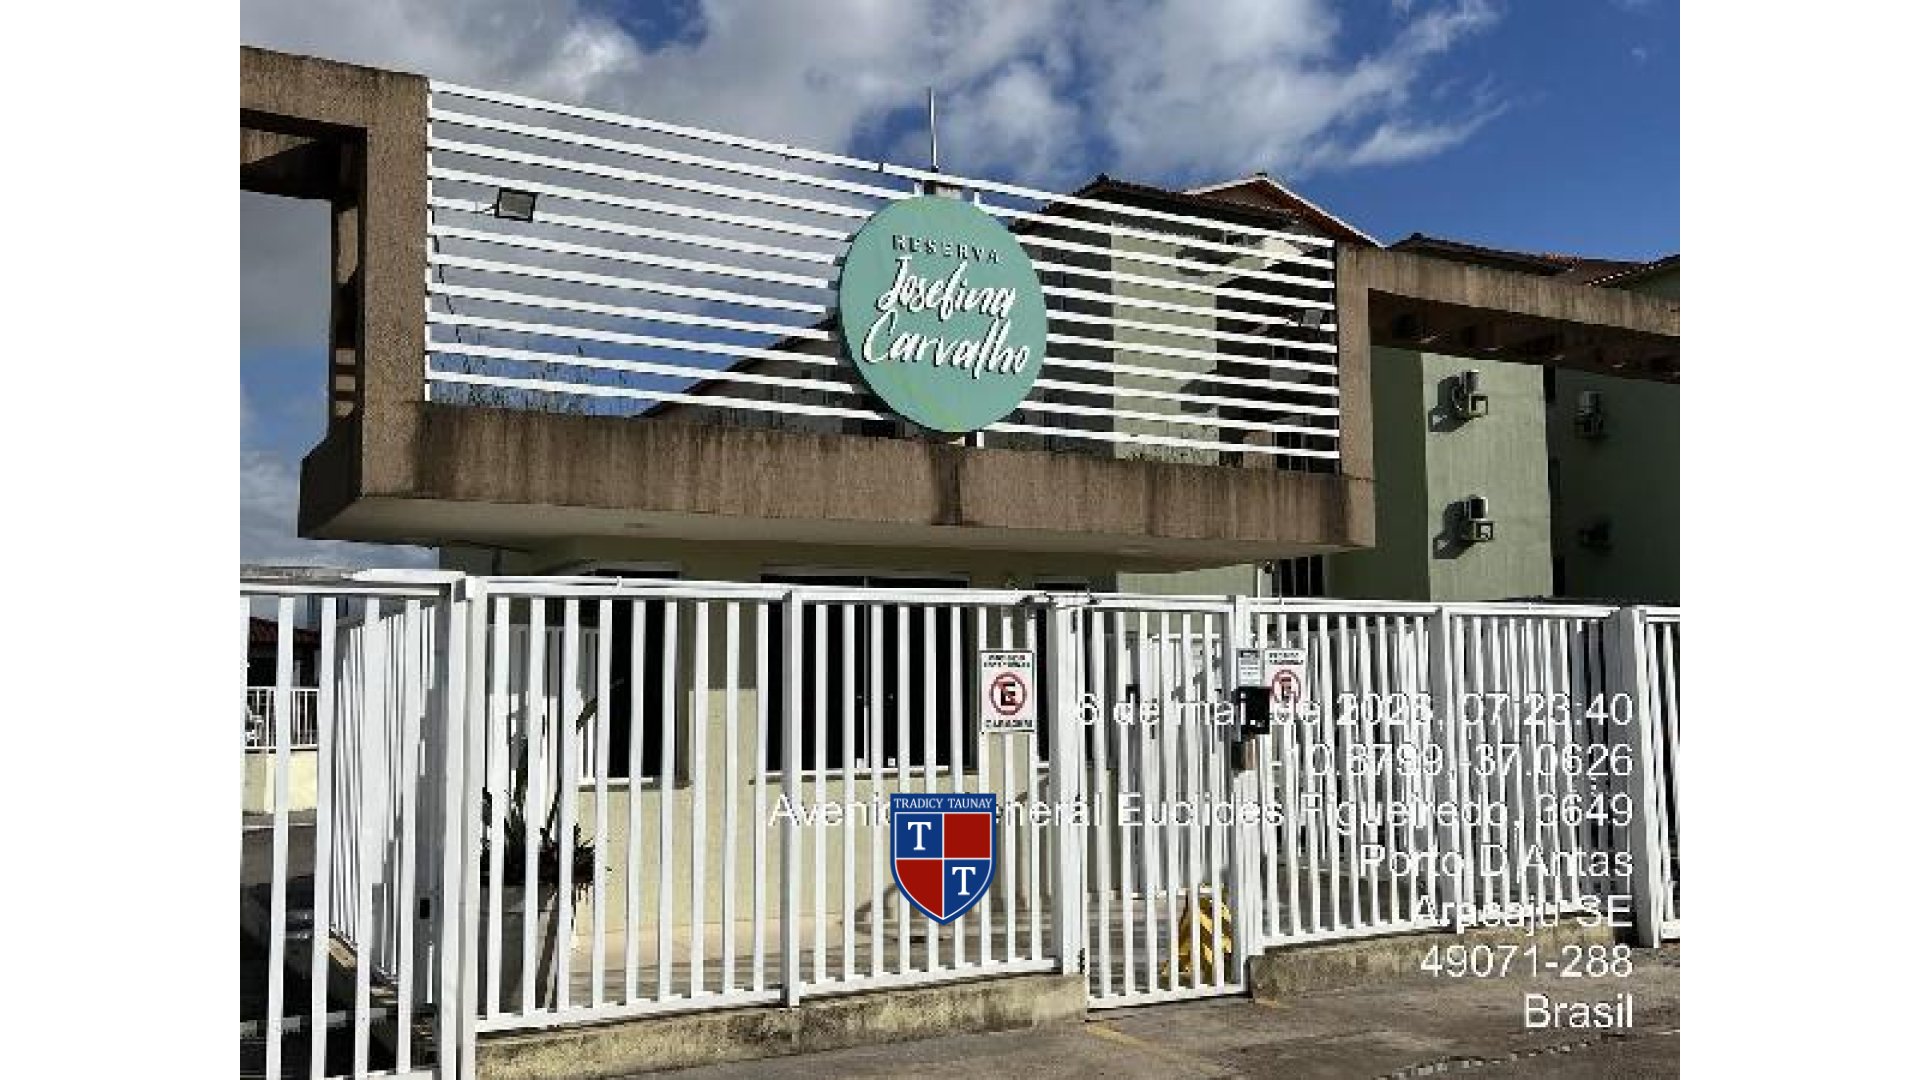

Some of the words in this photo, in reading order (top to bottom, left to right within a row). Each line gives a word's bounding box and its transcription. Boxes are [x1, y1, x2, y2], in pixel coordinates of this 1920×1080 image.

[892, 234, 1004, 264] RESERVA
[875, 256, 1017, 322] Josefina
[862, 309, 1031, 380] Carvalho
